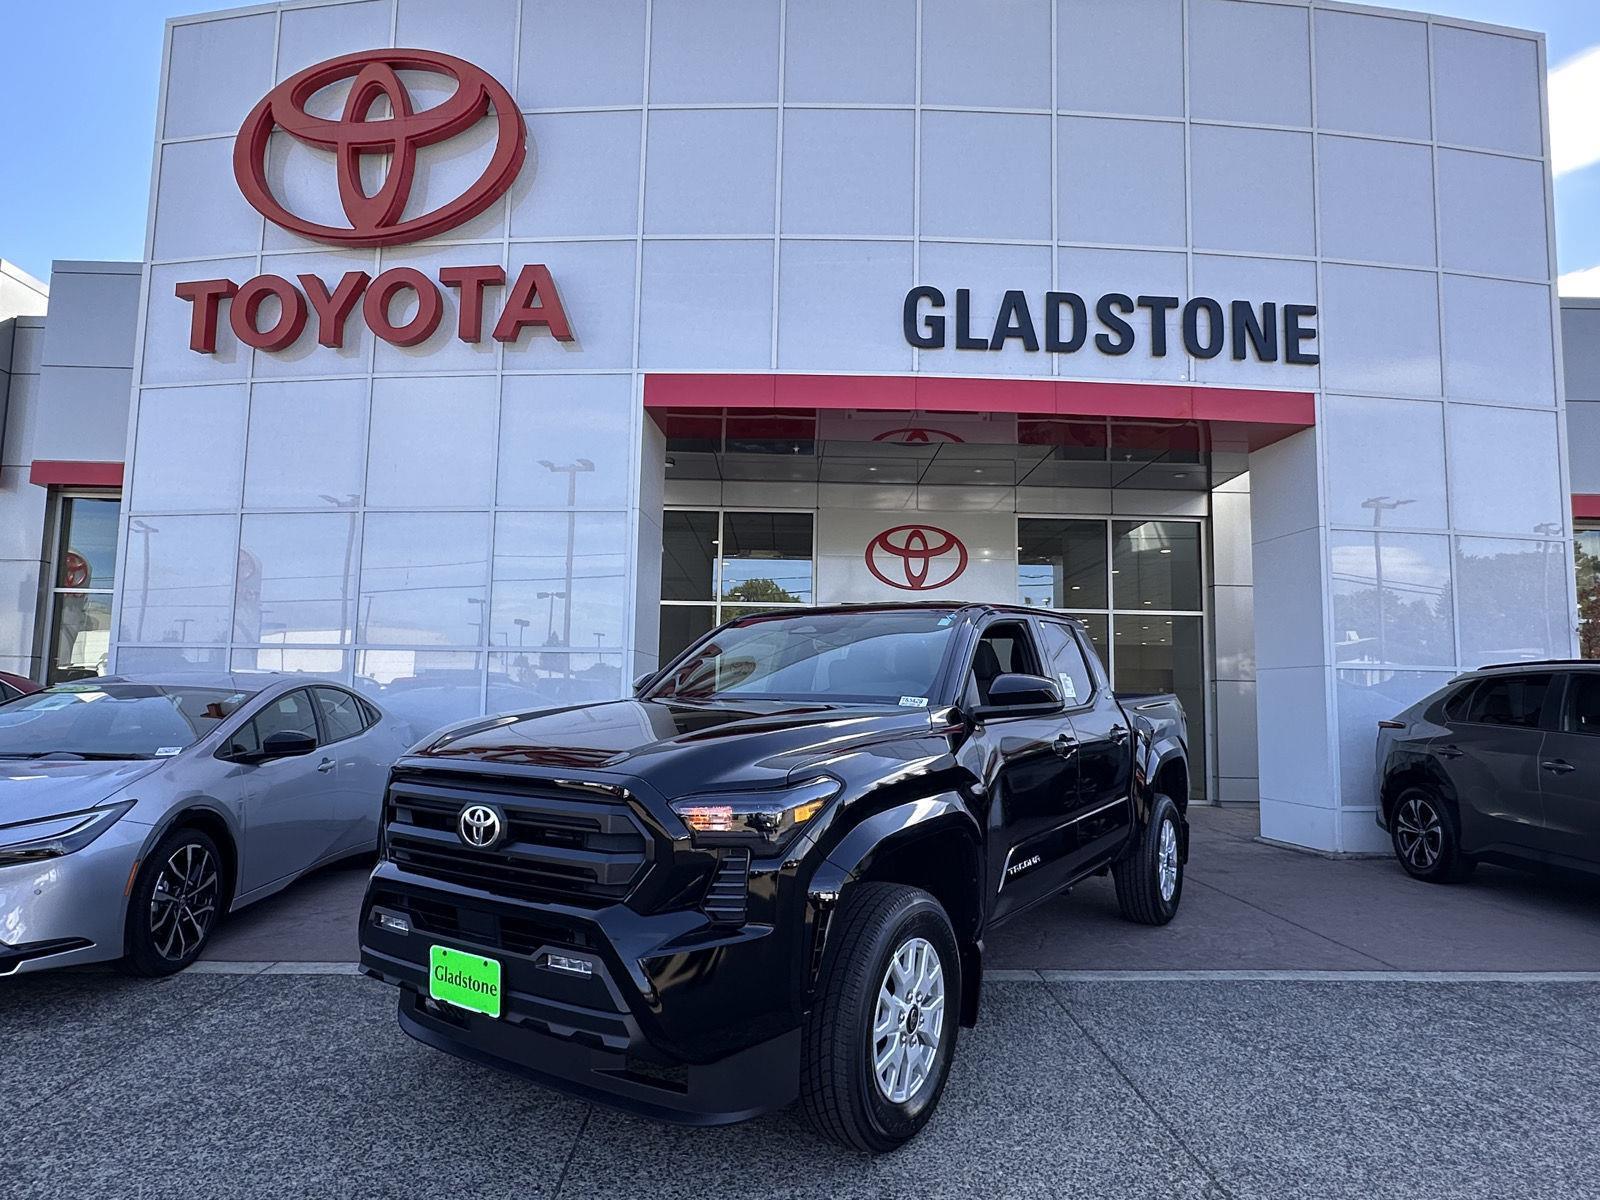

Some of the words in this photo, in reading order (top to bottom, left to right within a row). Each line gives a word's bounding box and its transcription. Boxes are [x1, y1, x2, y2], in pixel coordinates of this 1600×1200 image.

[175, 264, 575, 354] TOYOTA
[903, 285, 1320, 365] GLADSTONE
[434, 965, 497, 997] Gladstone
